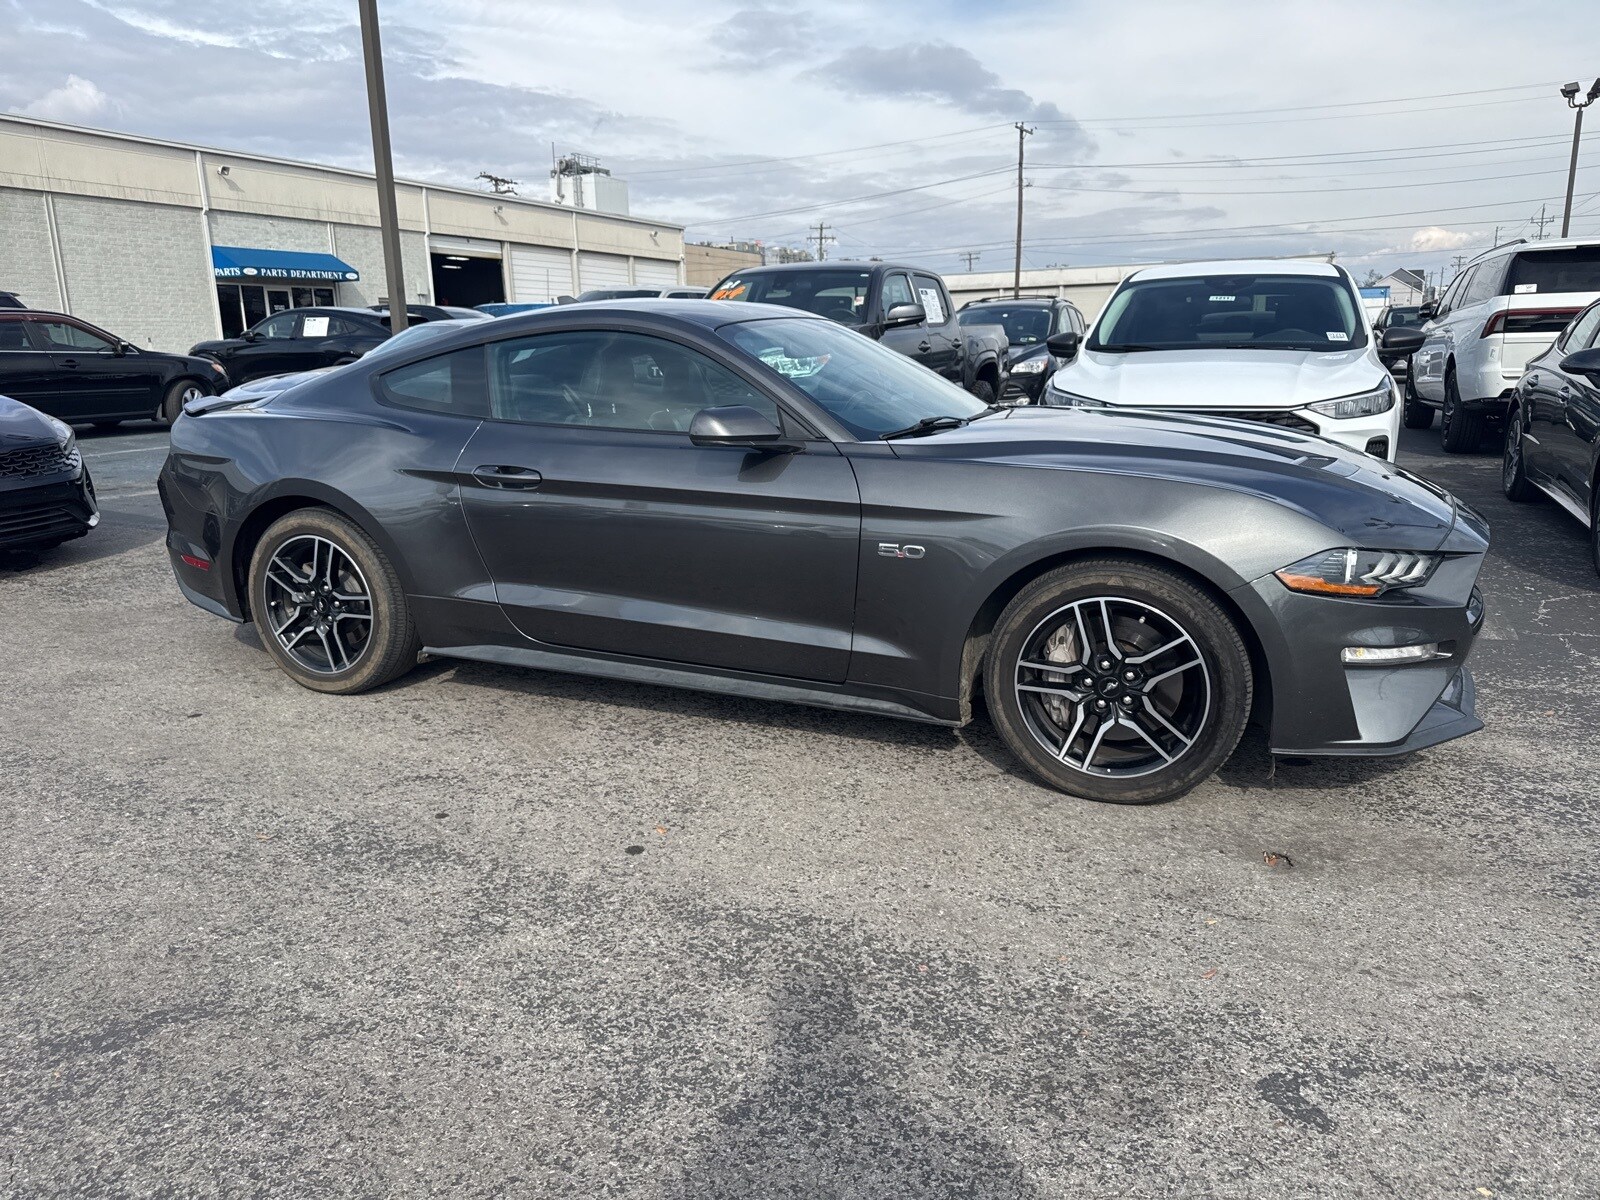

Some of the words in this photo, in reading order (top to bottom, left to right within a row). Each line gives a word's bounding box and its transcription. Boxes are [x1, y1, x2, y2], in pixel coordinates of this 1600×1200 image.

[214, 267, 241, 277] PARTS
[261, 268, 287, 277] PARTS
[290, 269, 343, 280] DEPARTMENT
[878, 543, 926, 559] 5.0
